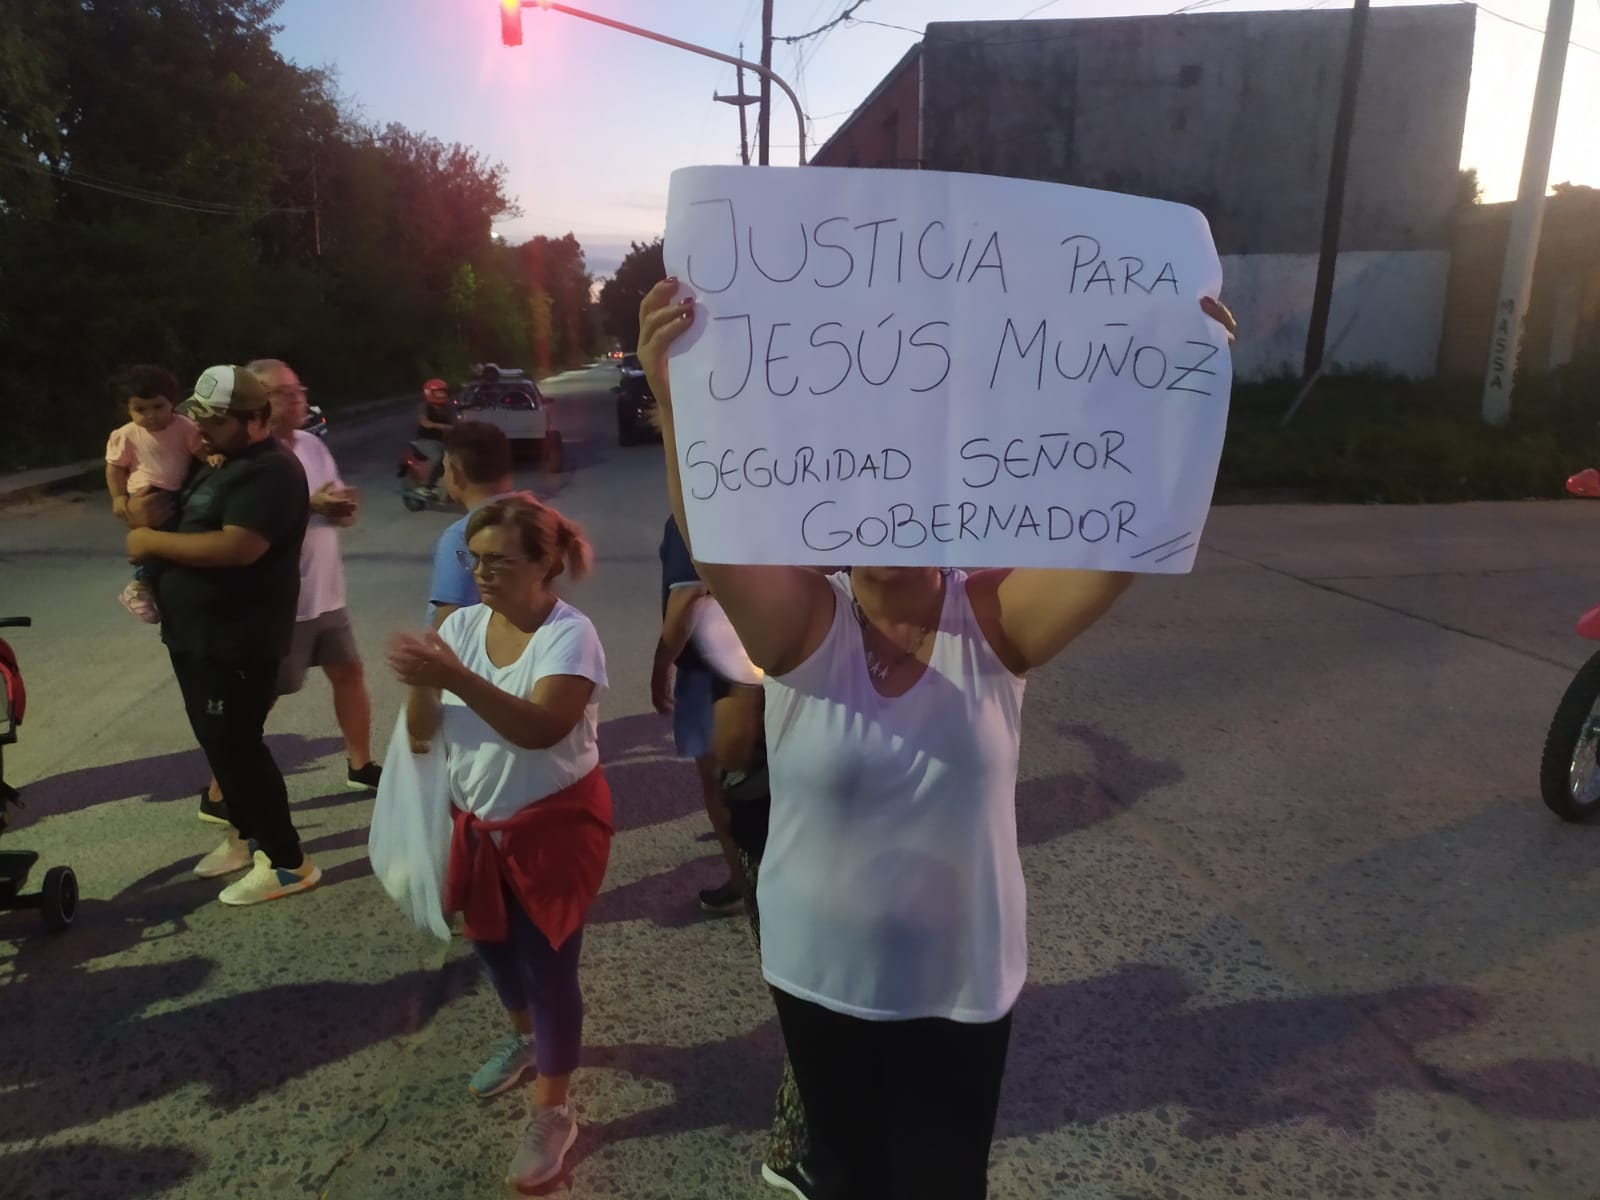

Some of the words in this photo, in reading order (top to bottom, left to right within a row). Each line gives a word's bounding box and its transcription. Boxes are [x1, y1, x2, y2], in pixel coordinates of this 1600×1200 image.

[708, 313, 950, 400] JESÚS
[990, 317, 1219, 396] MUÑOZ
[960, 430, 1132, 488] SEÑOR
[801, 500, 1140, 551] GOBERNADOR
